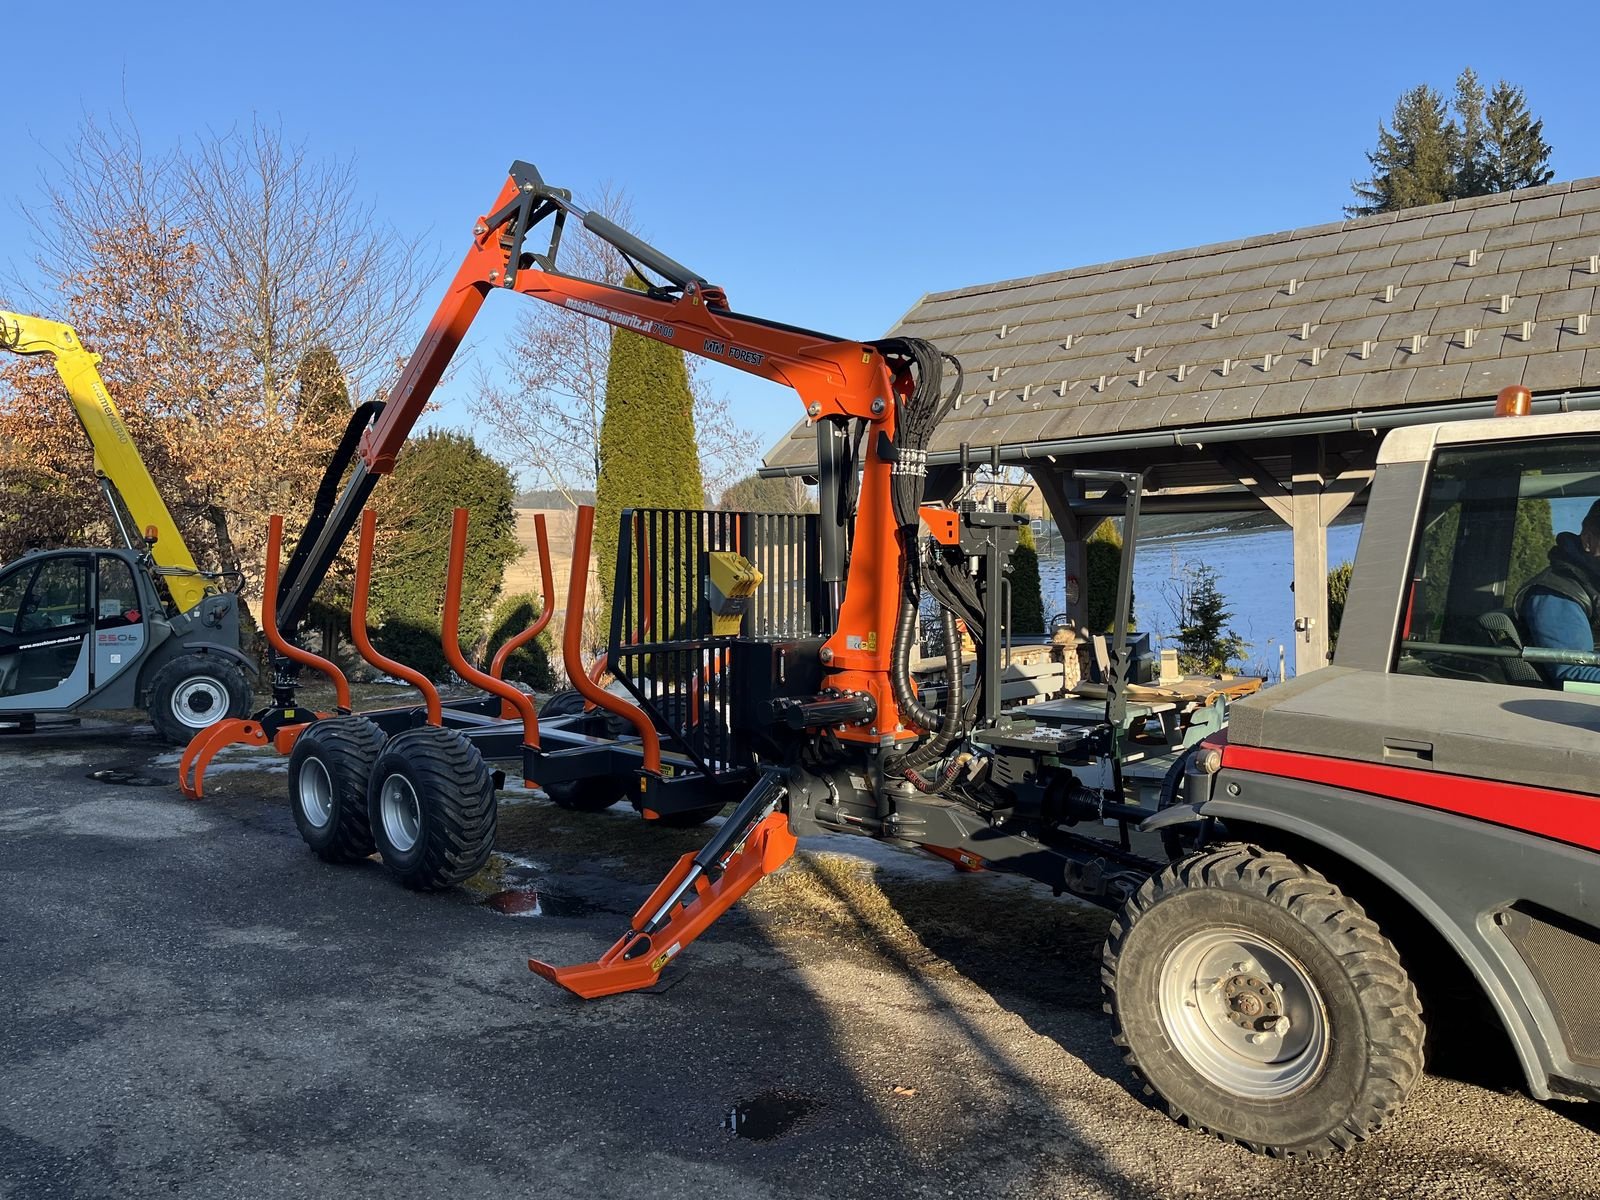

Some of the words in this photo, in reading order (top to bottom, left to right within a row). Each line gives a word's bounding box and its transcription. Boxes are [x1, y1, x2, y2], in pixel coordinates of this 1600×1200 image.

[565, 298, 653, 332] maschinen-mauritz.at
[703, 339, 725, 355] MTM
[728, 347, 763, 365] FOREST
